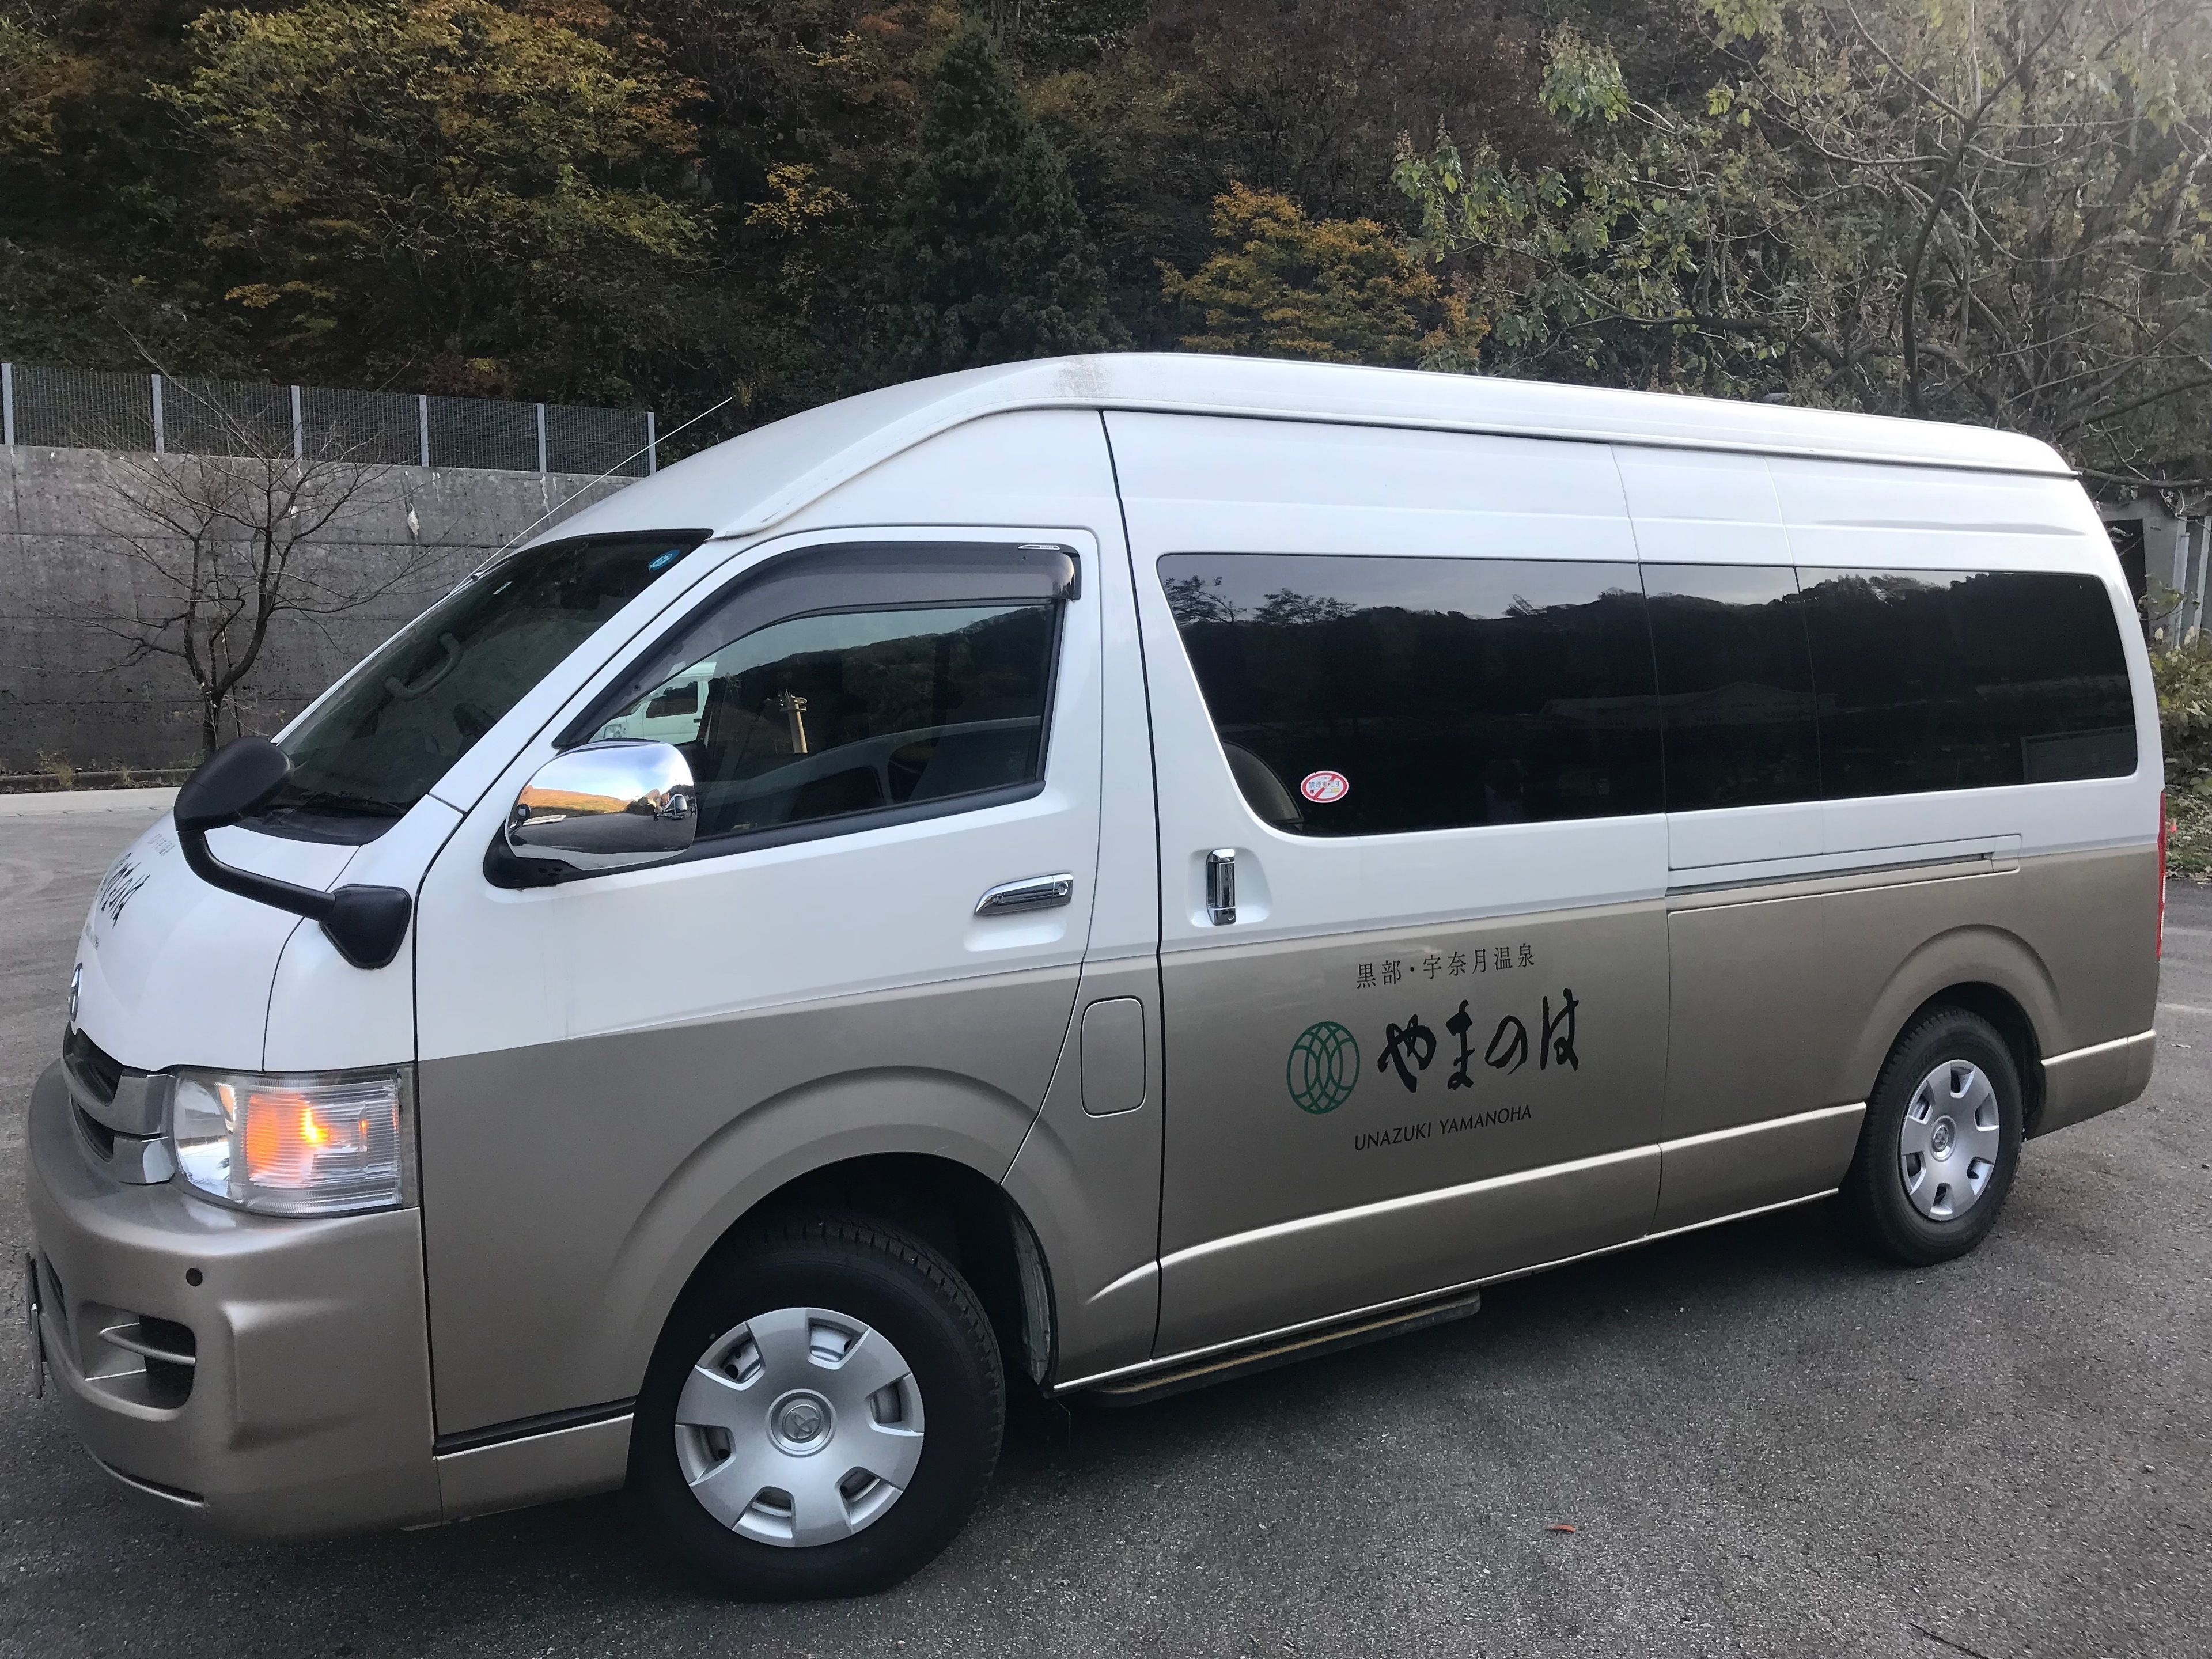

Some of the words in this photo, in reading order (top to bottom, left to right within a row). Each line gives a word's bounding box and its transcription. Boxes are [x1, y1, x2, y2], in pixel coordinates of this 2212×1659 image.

[1356, 942, 1535, 990] 黒部・宇奈月温泉
[1377, 988, 1580, 1093] やまのは
[1354, 1122, 1432, 1151] UNAZUKI
[1440, 1104, 1532, 1135] YAMANOHA
